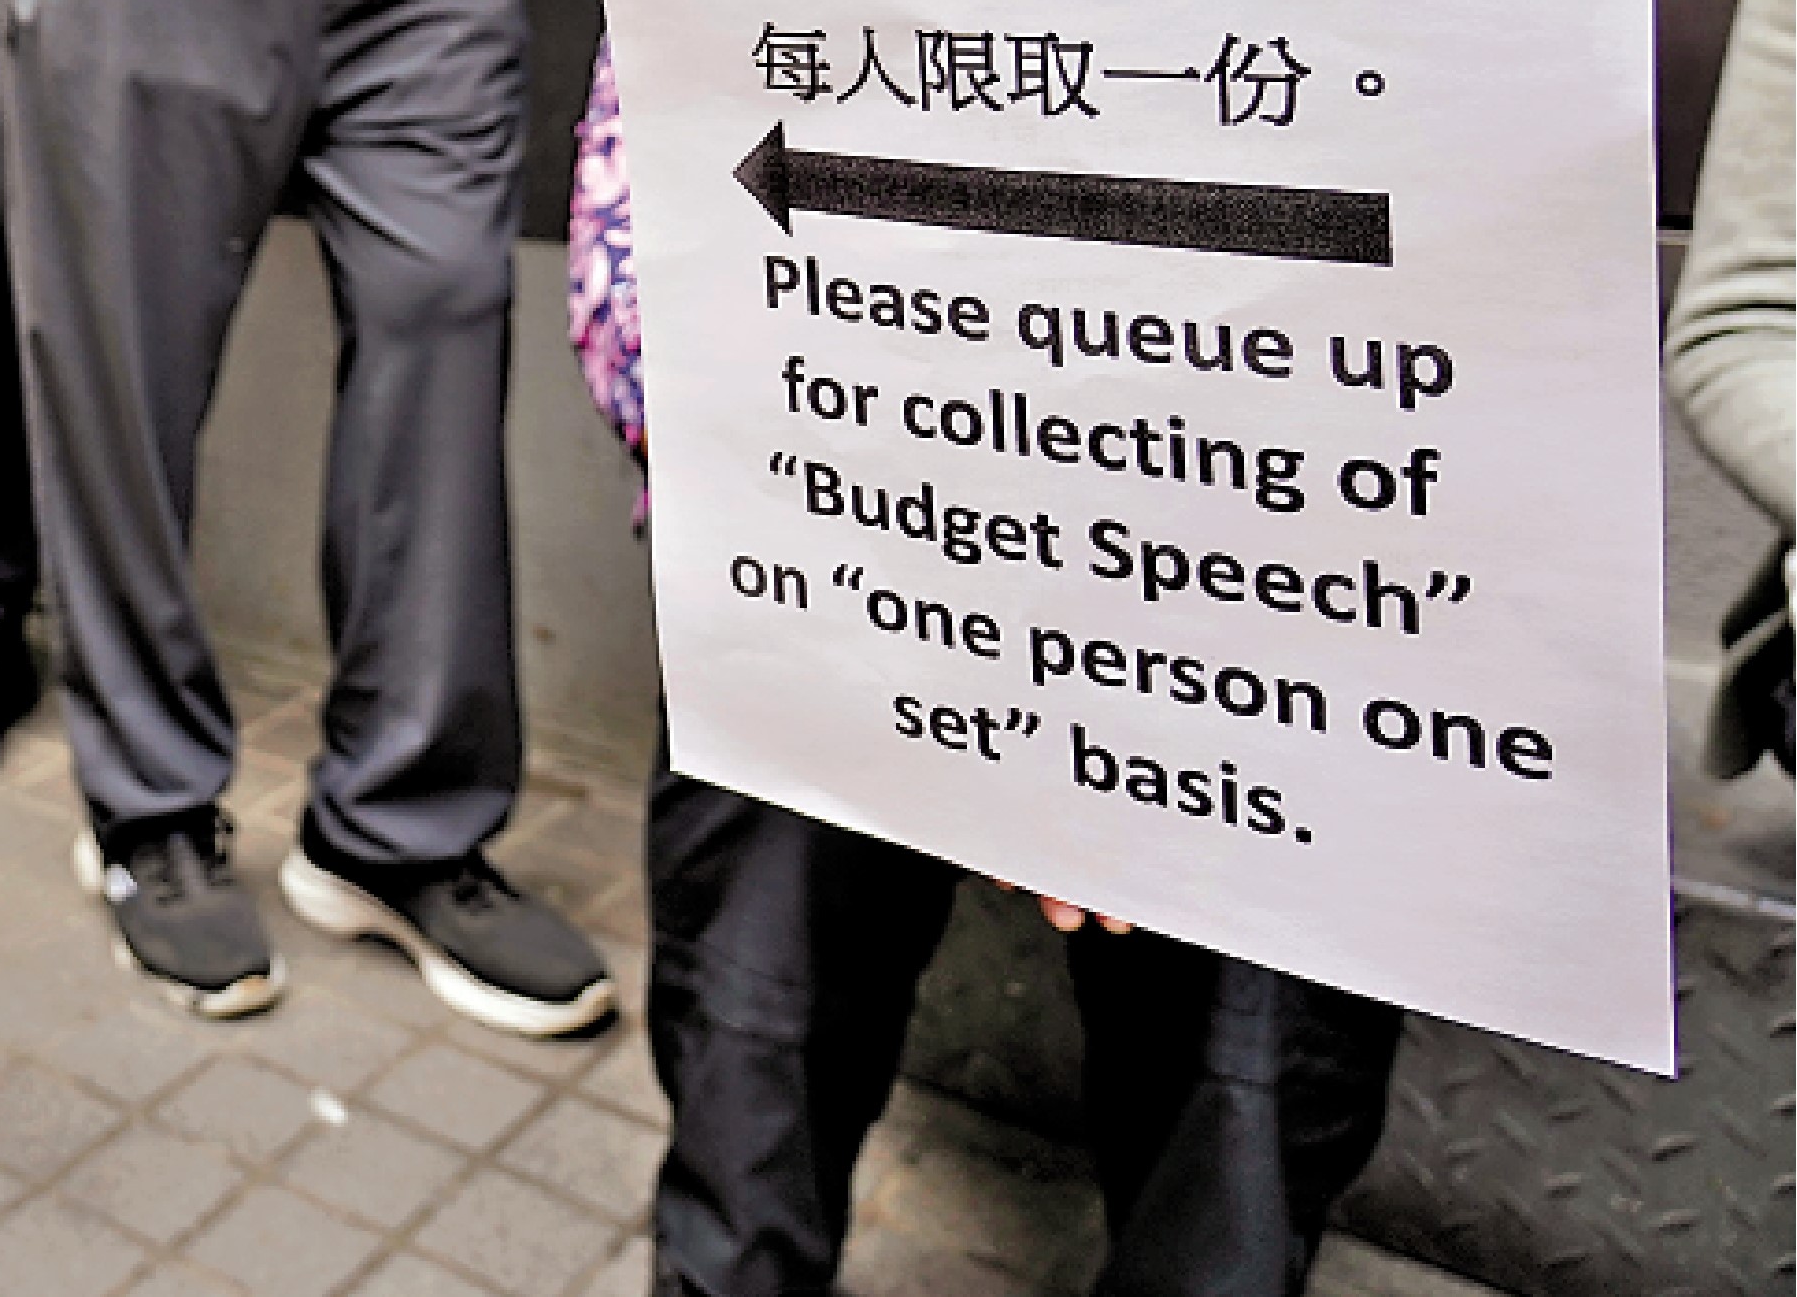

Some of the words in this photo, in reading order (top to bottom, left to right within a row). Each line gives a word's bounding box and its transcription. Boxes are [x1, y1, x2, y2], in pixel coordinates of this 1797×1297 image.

[750, 20, 1388, 127] 每人限取一份。
[762, 254, 991, 343] Please
[1017, 302, 1295, 380] queue
[1328, 335, 1454, 412] up
[780, 354, 880, 428] for
[902, 387, 1306, 514] collecting
[1339, 447, 1443, 517] of
[768, 450, 1065, 568] “Budget
[1087, 517, 1472, 636] Speech”
[729, 554, 809, 610] on
[831, 562, 1002, 662] “one
[1028, 625, 1328, 733] person
[1361, 699, 1554, 781] one
[891, 694, 1043, 762] set”
[1068, 721, 1313, 844] basis.
